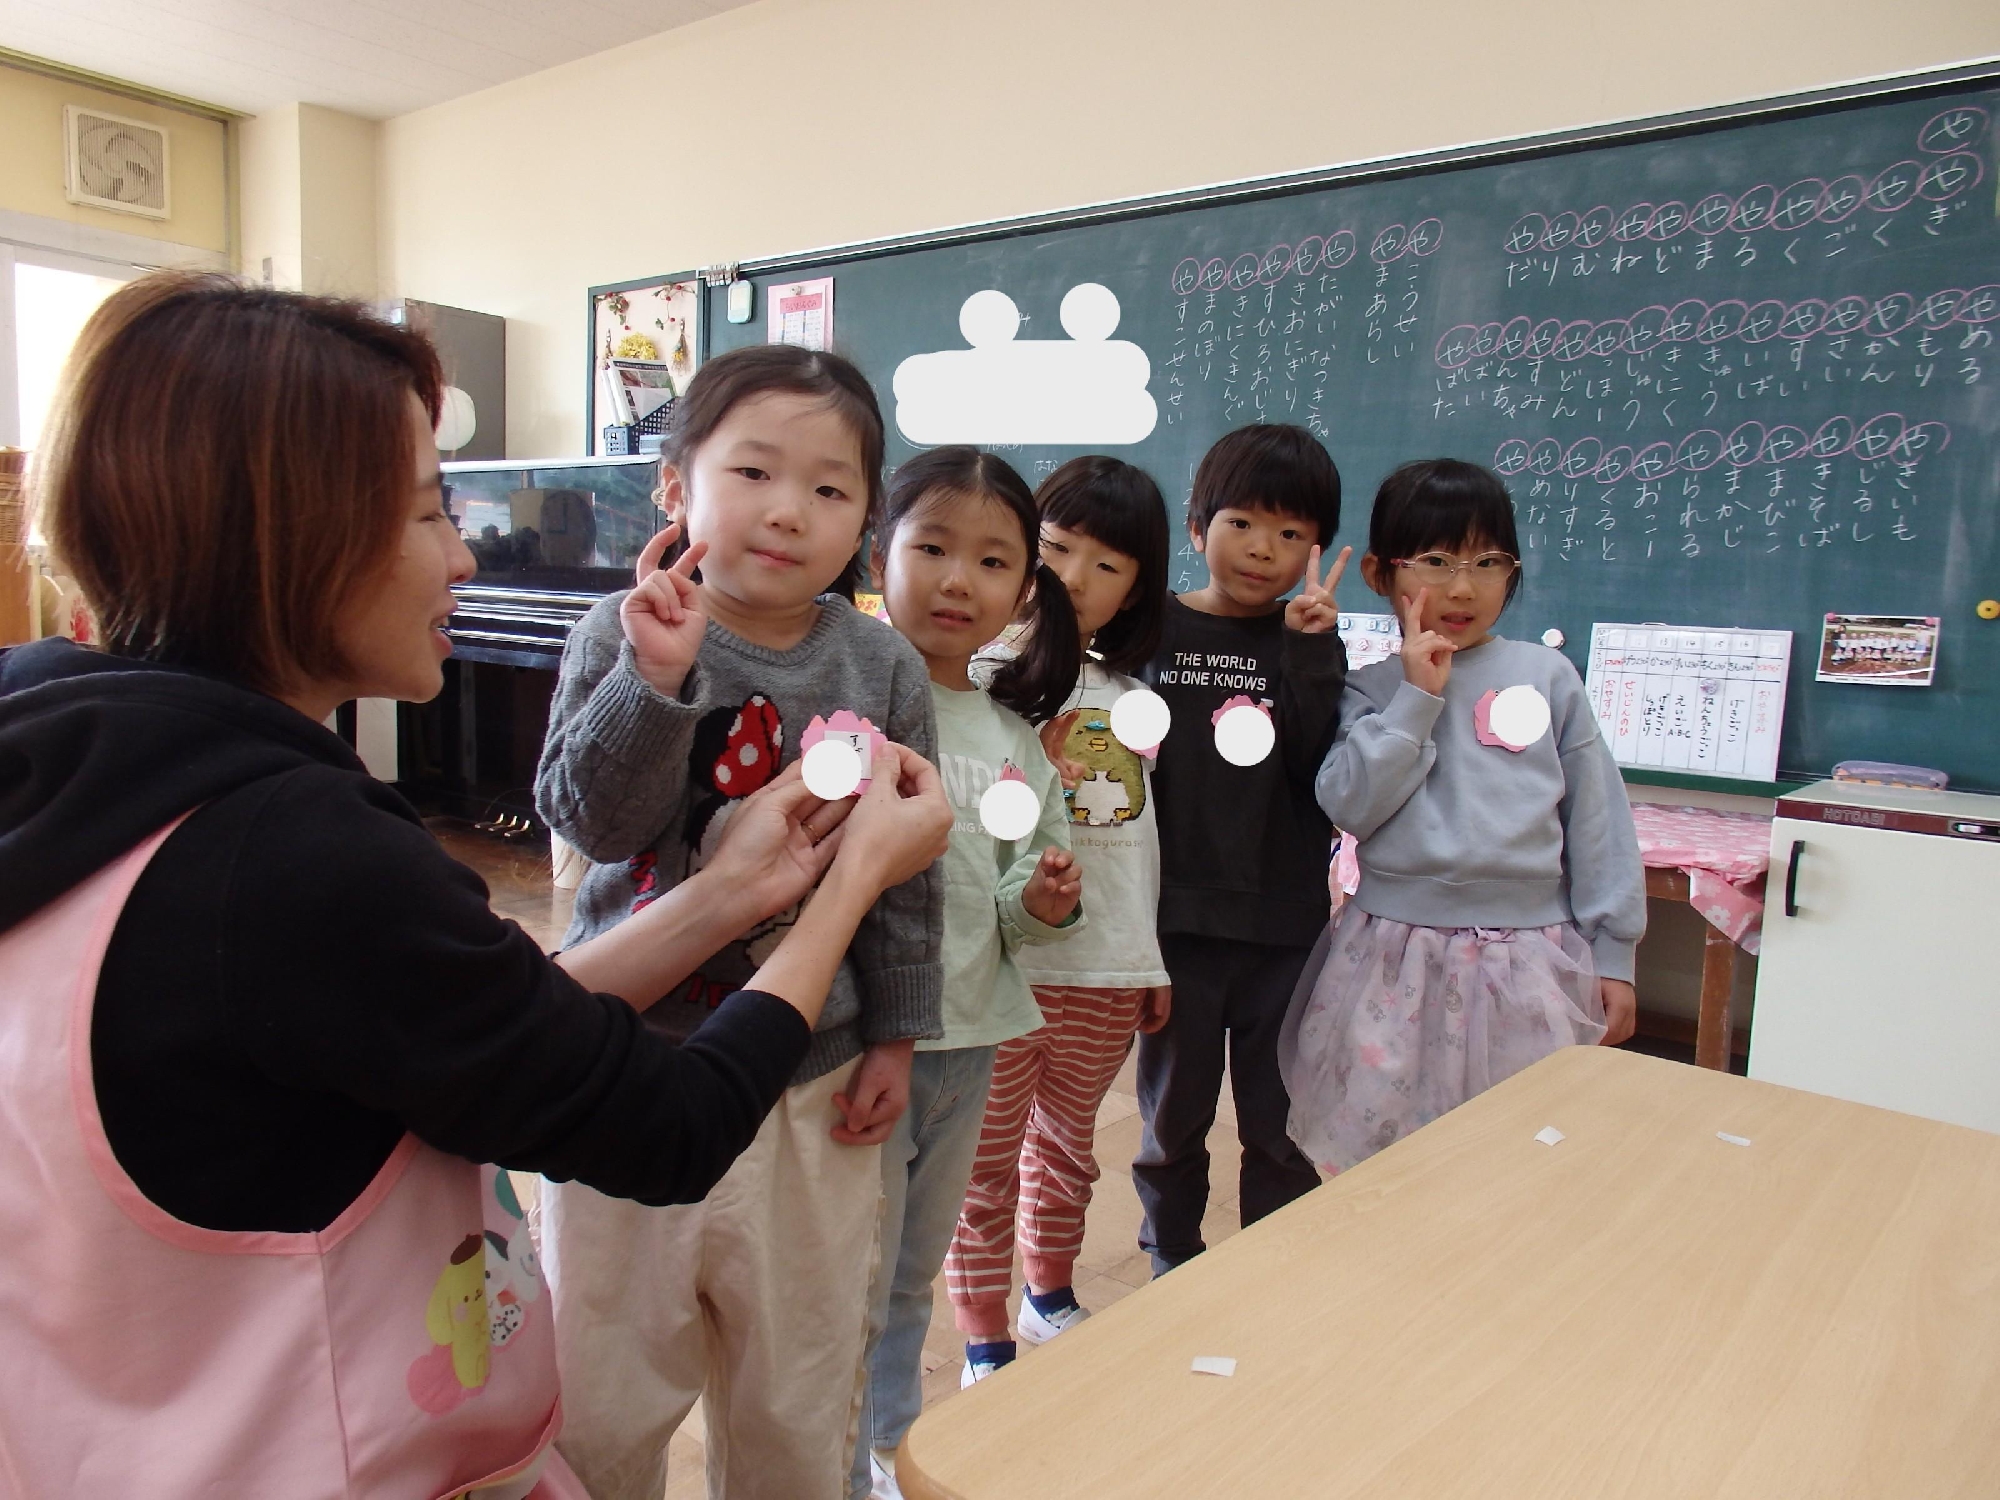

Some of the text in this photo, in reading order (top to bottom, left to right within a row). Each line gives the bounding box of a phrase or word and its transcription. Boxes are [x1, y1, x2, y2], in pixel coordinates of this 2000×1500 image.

[1926, 112, 1974, 143] や
[1520, 329, 1552, 411] やすみ
[1551, 331, 1584, 419] やどん
[1656, 315, 1693, 427] やきにく
[1822, 302, 1860, 382] やさい
[1860, 299, 1901, 384] やかん
[1906, 294, 1954, 388] やもり
[1955, 292, 1995, 385] やめる
[1526, 448, 1552, 549] やめない
[1559, 451, 1587, 561] やりすぎ
[1593, 455, 1621, 561] やくると
[1757, 433, 1796, 553] やまびこ
[1798, 427, 1841, 547] やきそば
[1852, 428, 1890, 542] やじるし
[1889, 426, 1929, 541] やきいも
[1159, 670, 1267, 692] NO ONE KNOWS
[1174, 652, 1257, 671] THE WORLD
